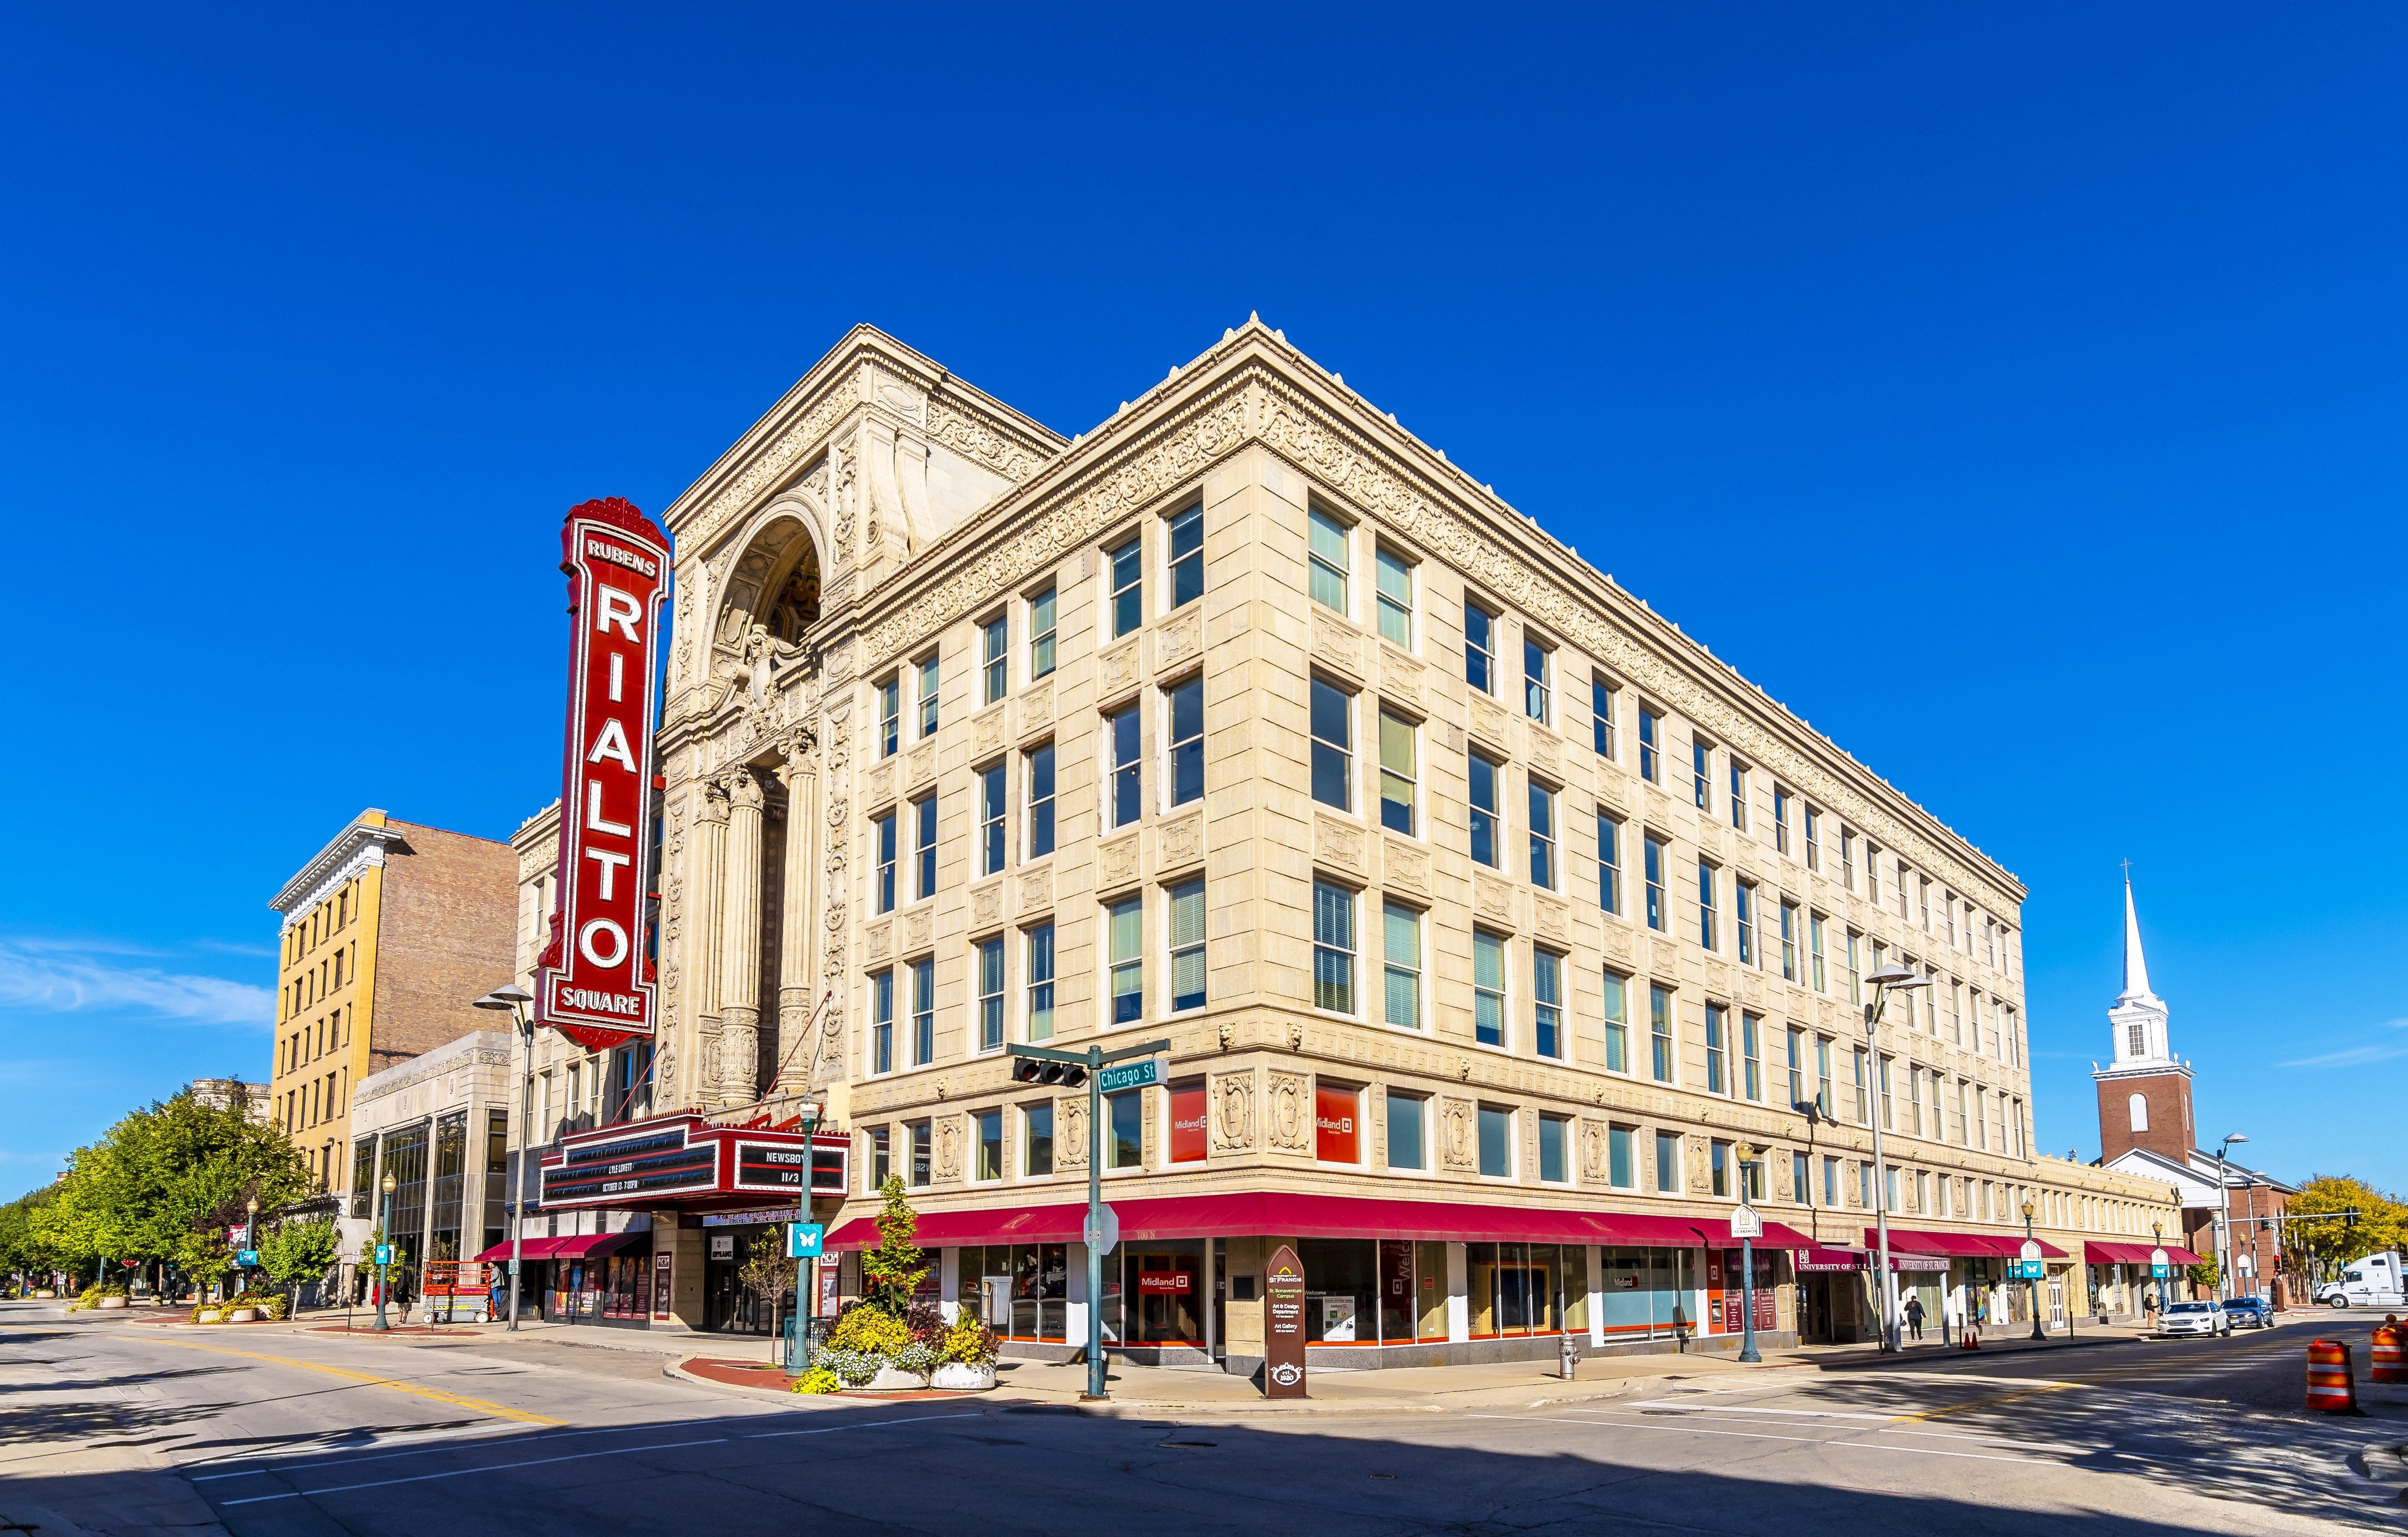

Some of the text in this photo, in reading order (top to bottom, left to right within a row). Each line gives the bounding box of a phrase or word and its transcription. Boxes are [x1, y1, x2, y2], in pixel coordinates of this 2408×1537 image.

[587, 539, 656, 577] RUBENS
[579, 583, 642, 969] RIALTO
[561, 987, 641, 1016] SQUARE
[1101, 1063, 1154, 1087] Chicago St
[1175, 1118, 1199, 1130] Midland
[608, 1162, 632, 1174] LYLE LOVETT
[781, 1172, 799, 1182] 11/3
[603, 1182, 618, 1192] OCTOBER
[624, 1179, 638, 1189] 7:00PM
[1150, 1230, 1155, 1239] N
[1899, 1260, 1923, 1270] UNIVERSITY
[1923, 1261, 1928, 1270] OF
[1934, 1260, 1950, 1270] FRANCIS
[1614, 1277, 1632, 1287] Midland
